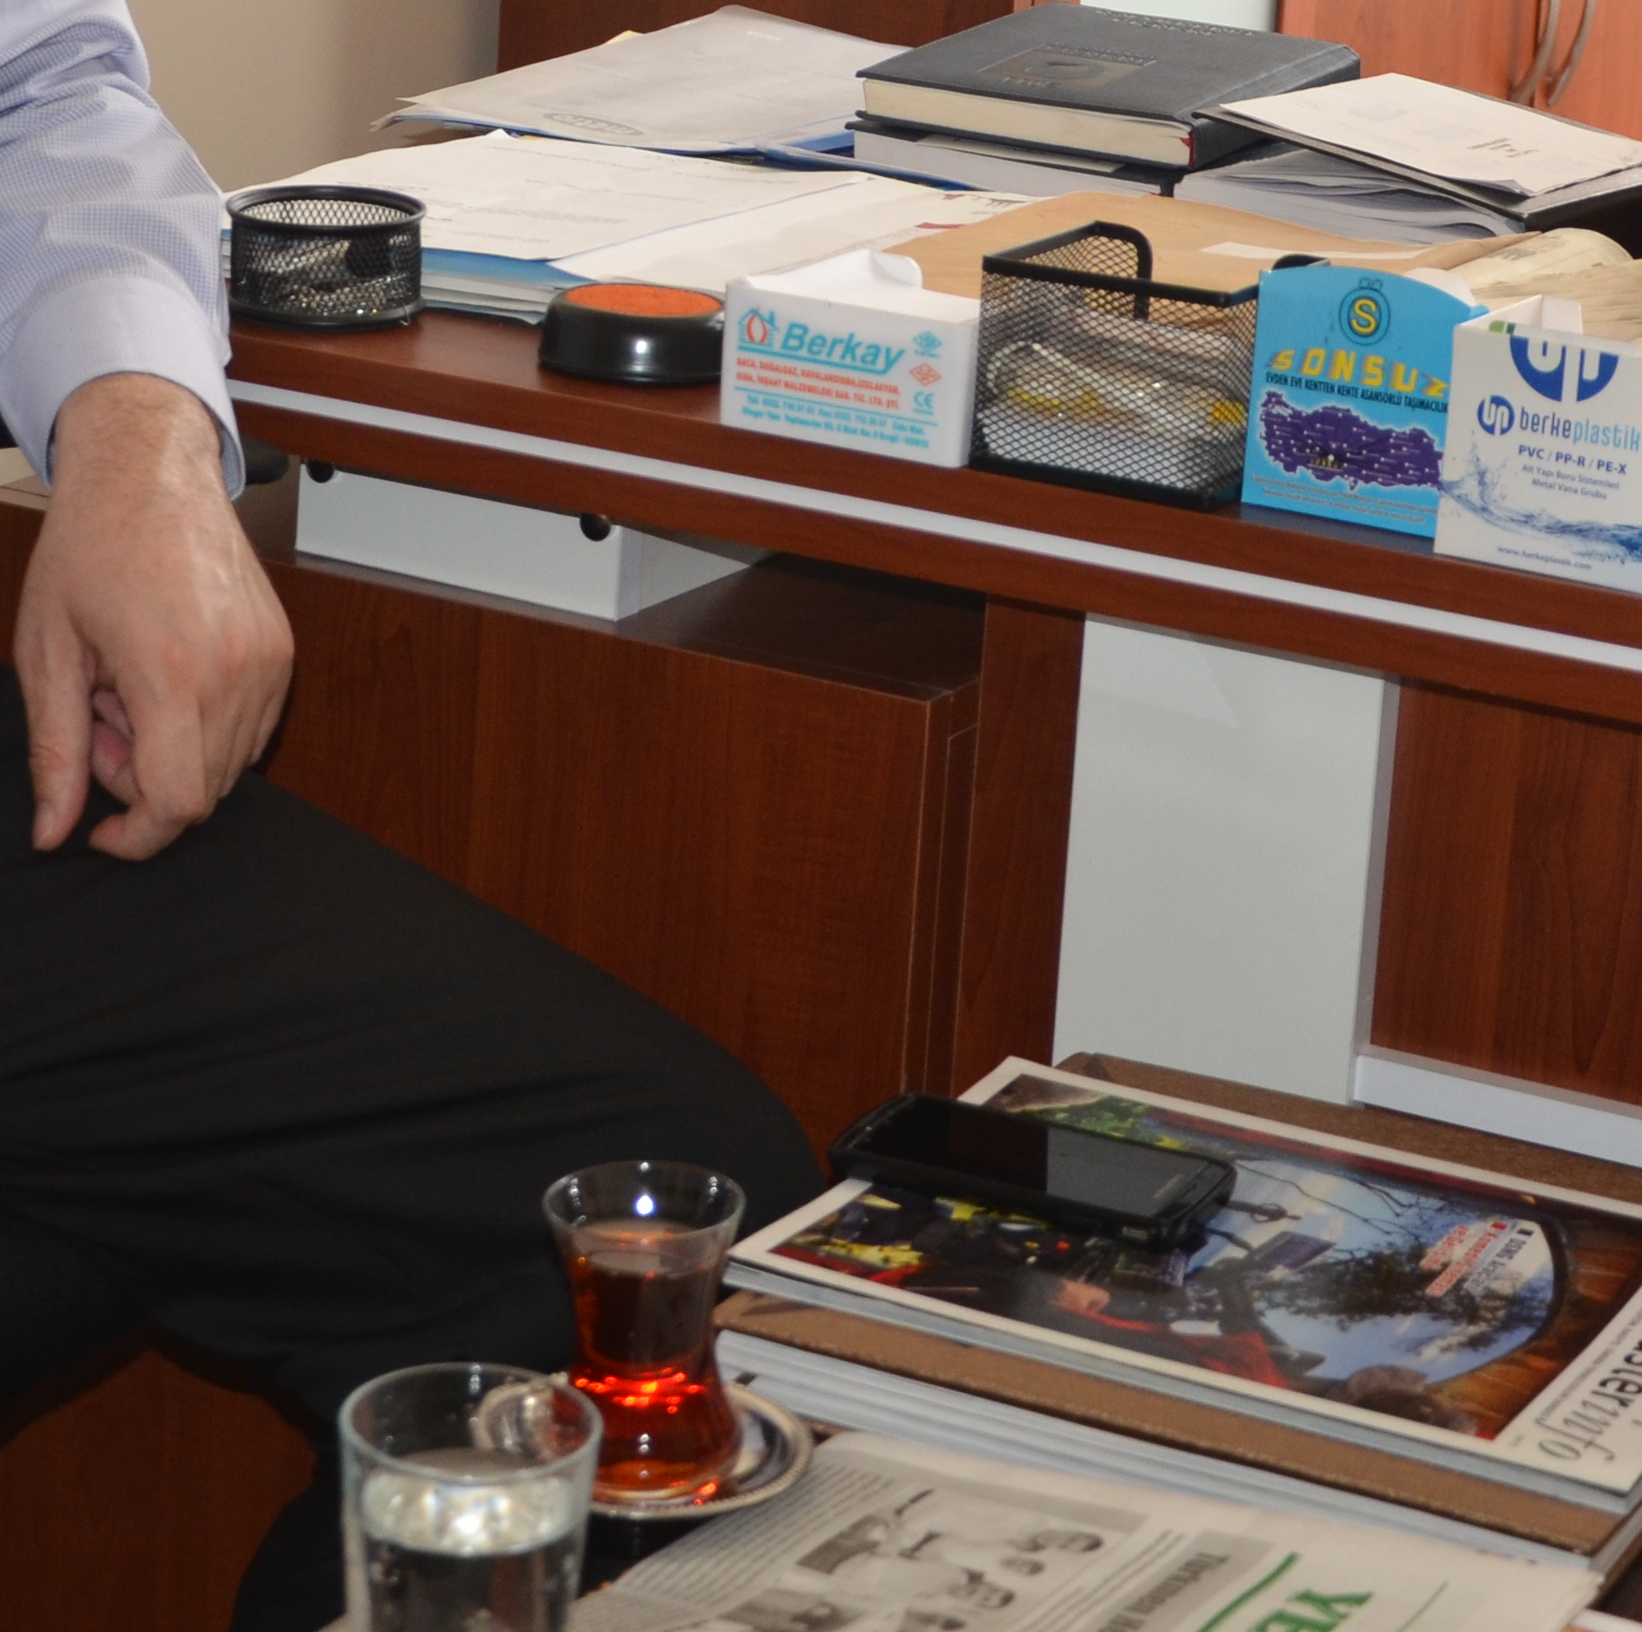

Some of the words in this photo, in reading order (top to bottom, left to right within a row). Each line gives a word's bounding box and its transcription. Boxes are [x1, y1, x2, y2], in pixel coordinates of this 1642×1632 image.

[1350, 297, 1379, 335] S
[780, 321, 906, 375] Berkay
[1266, 346, 1450, 399] SONSUZ
[1266, 372, 1289, 386] EVDEN
[1290, 375, 1303, 389] EVE
[1305, 378, 1336, 395] KENTTEN
[1337, 384, 1359, 399] KENTE
[1519, 406, 1641, 452] berkeplastik
[1518, 444, 1545, 460] PVC
[1555, 451, 1586, 468] PP-R
[1597, 459, 1628, 476] PE-X
[1522, 463, 1535, 474] Alt
[1536, 465, 1556, 478] Yapı
[1556, 469, 1577, 482] Boru
[1578, 474, 1621, 490] Sistemleri
[1531, 477, 1557, 490] Metal
[1557, 483, 1579, 495] Vana
[1580, 486, 1608, 500] Grubu
[1496, 544, 1593, 571] www.berkeplastik.com
